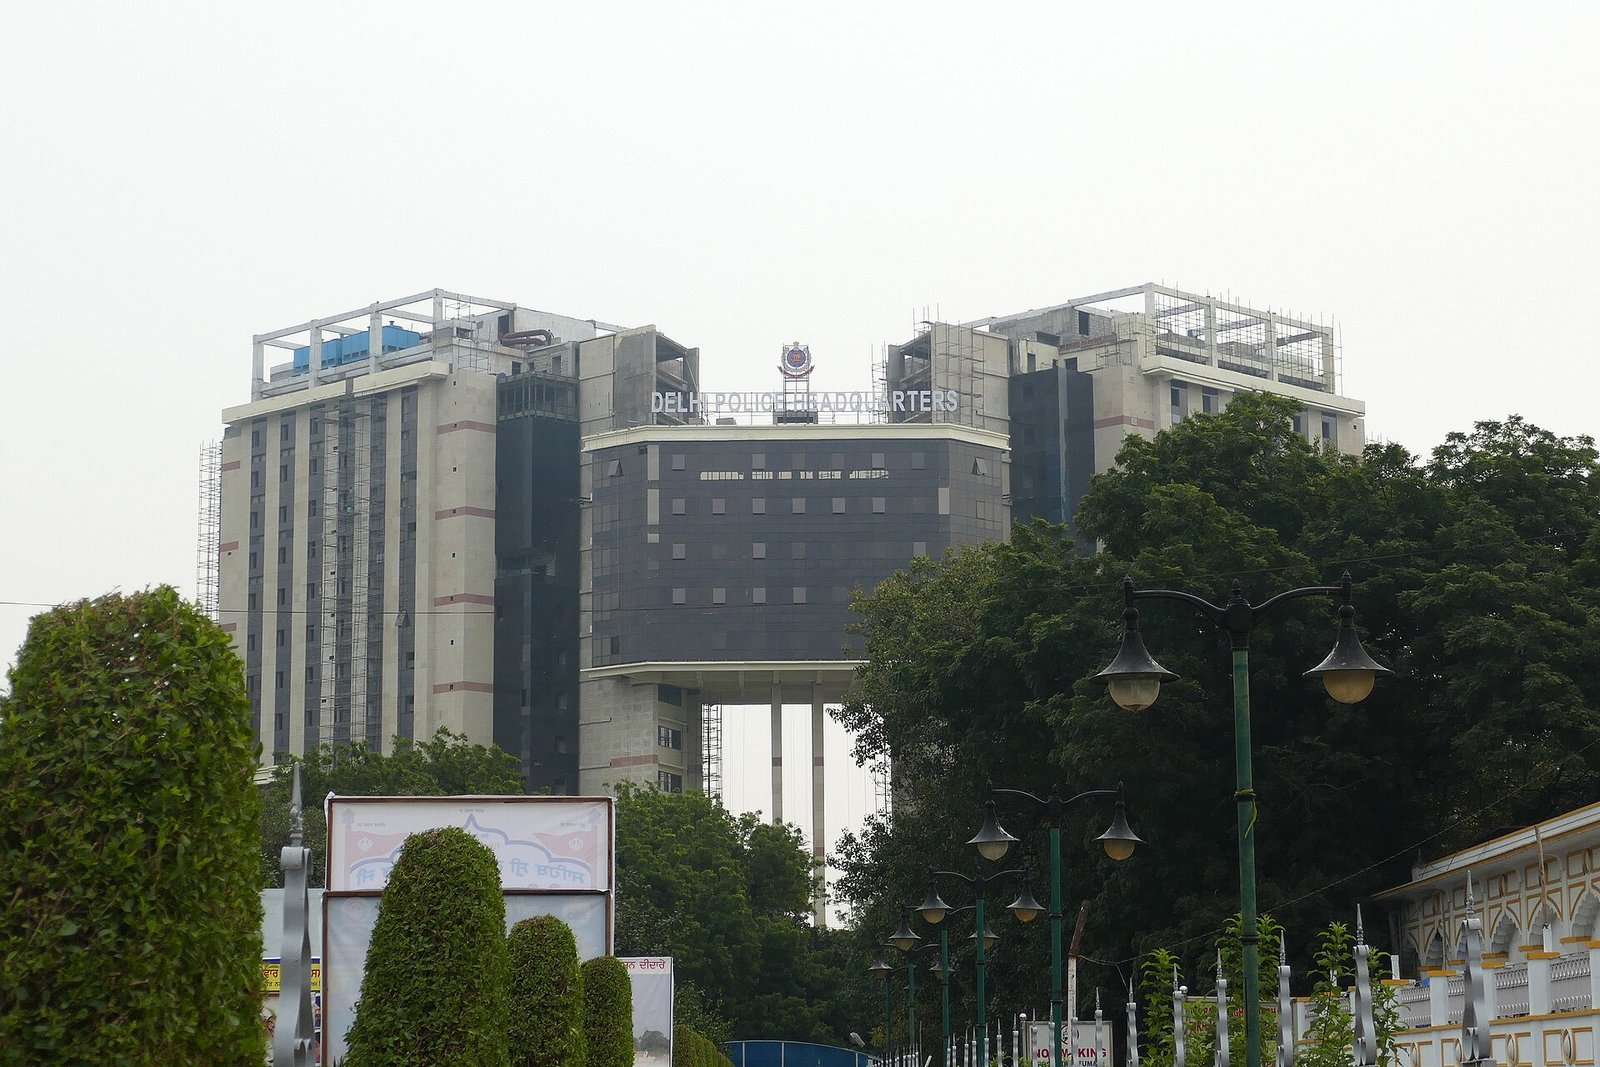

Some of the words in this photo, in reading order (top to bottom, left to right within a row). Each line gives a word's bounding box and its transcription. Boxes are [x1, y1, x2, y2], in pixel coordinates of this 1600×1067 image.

[651, 391, 707, 413] DELHI
[715, 391, 785, 413] POLICE
[794, 390, 959, 412] HEADQUARTERS
[1061, 1048, 1108, 1058] MKING
